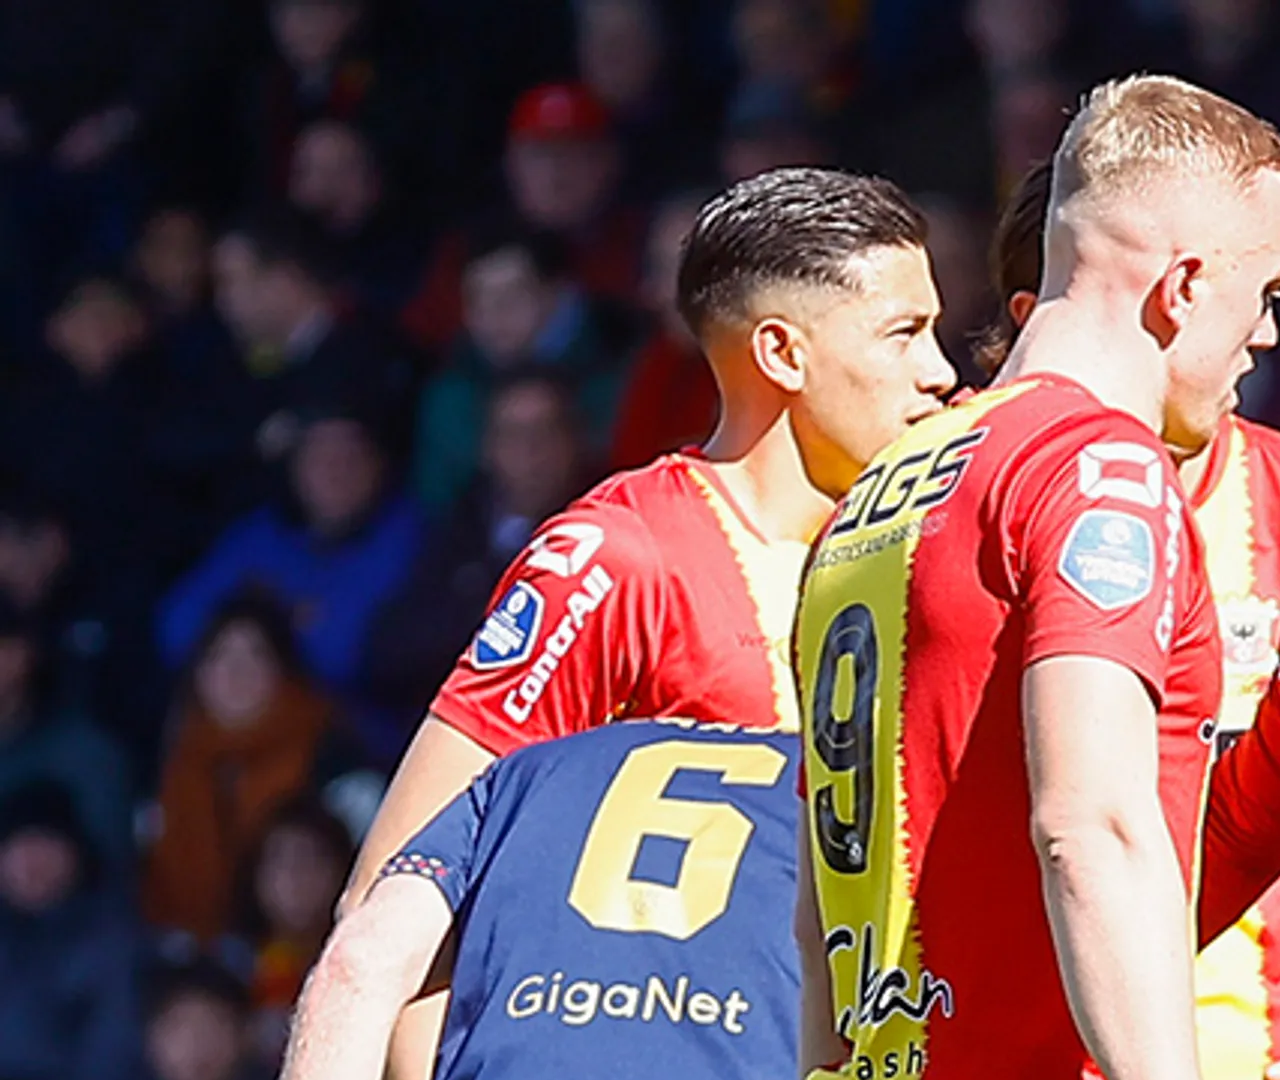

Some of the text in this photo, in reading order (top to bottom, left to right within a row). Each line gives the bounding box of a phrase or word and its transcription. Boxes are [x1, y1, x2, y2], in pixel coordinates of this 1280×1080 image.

[813, 603, 878, 875] 9
[567, 740, 787, 941] 6
[506, 971, 750, 1033] GigaNet
